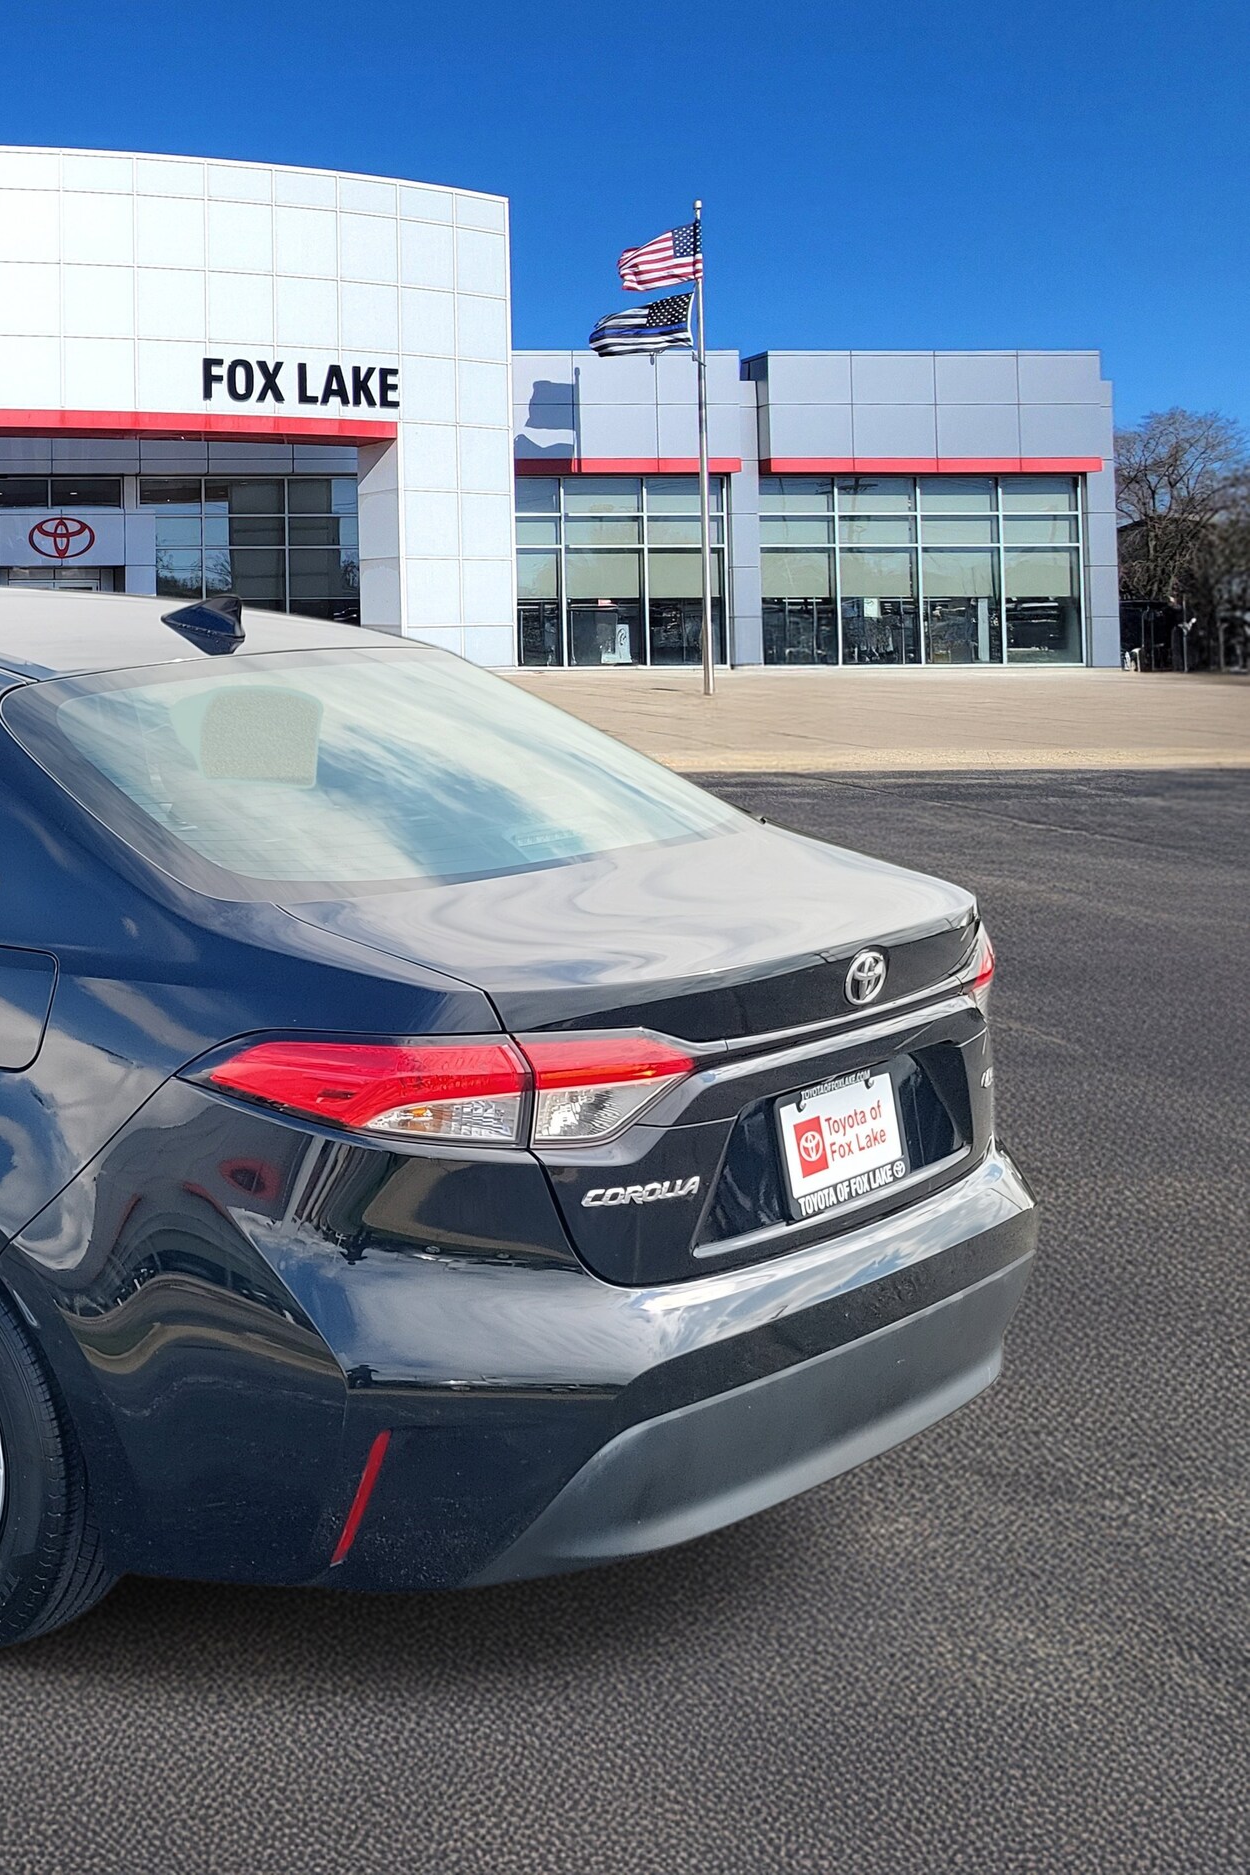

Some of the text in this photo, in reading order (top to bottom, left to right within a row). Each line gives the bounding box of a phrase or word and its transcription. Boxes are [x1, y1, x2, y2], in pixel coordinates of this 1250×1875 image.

[202, 357, 400, 409] FOX LAKE
[824, 1099, 882, 1137] Toyota of
[830, 1127, 887, 1162] Fox Lake
[581, 1176, 700, 1207] COROLLA
[797, 1163, 894, 1216] TOYOTA OF FOX LAKE
